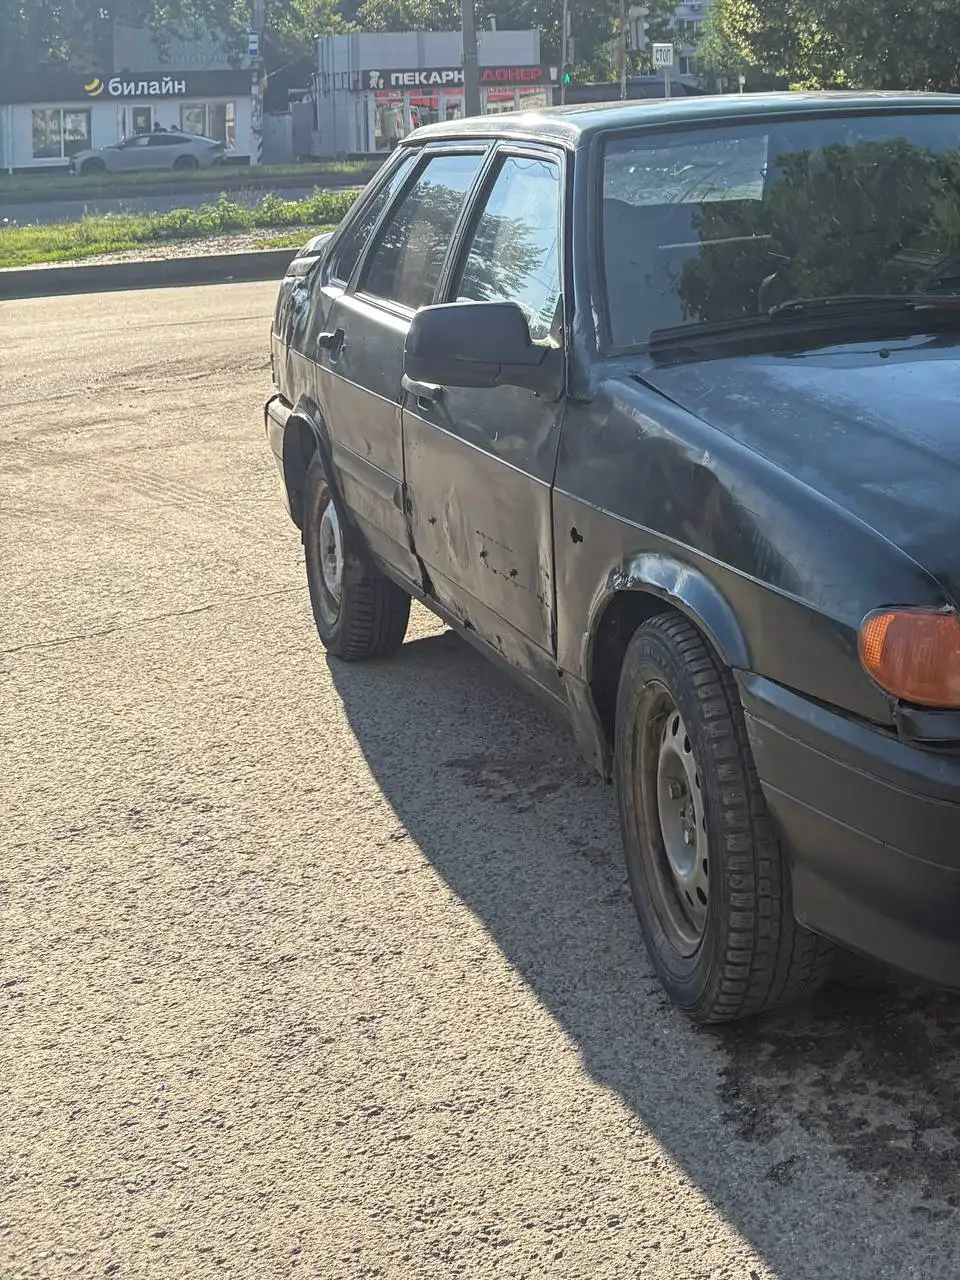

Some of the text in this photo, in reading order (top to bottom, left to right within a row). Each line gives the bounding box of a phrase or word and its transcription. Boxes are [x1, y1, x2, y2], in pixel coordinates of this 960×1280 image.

[655, 48, 671, 63] СТОП
[481, 67, 542, 82] ДОНЕР
[109, 76, 186, 96] билайн
